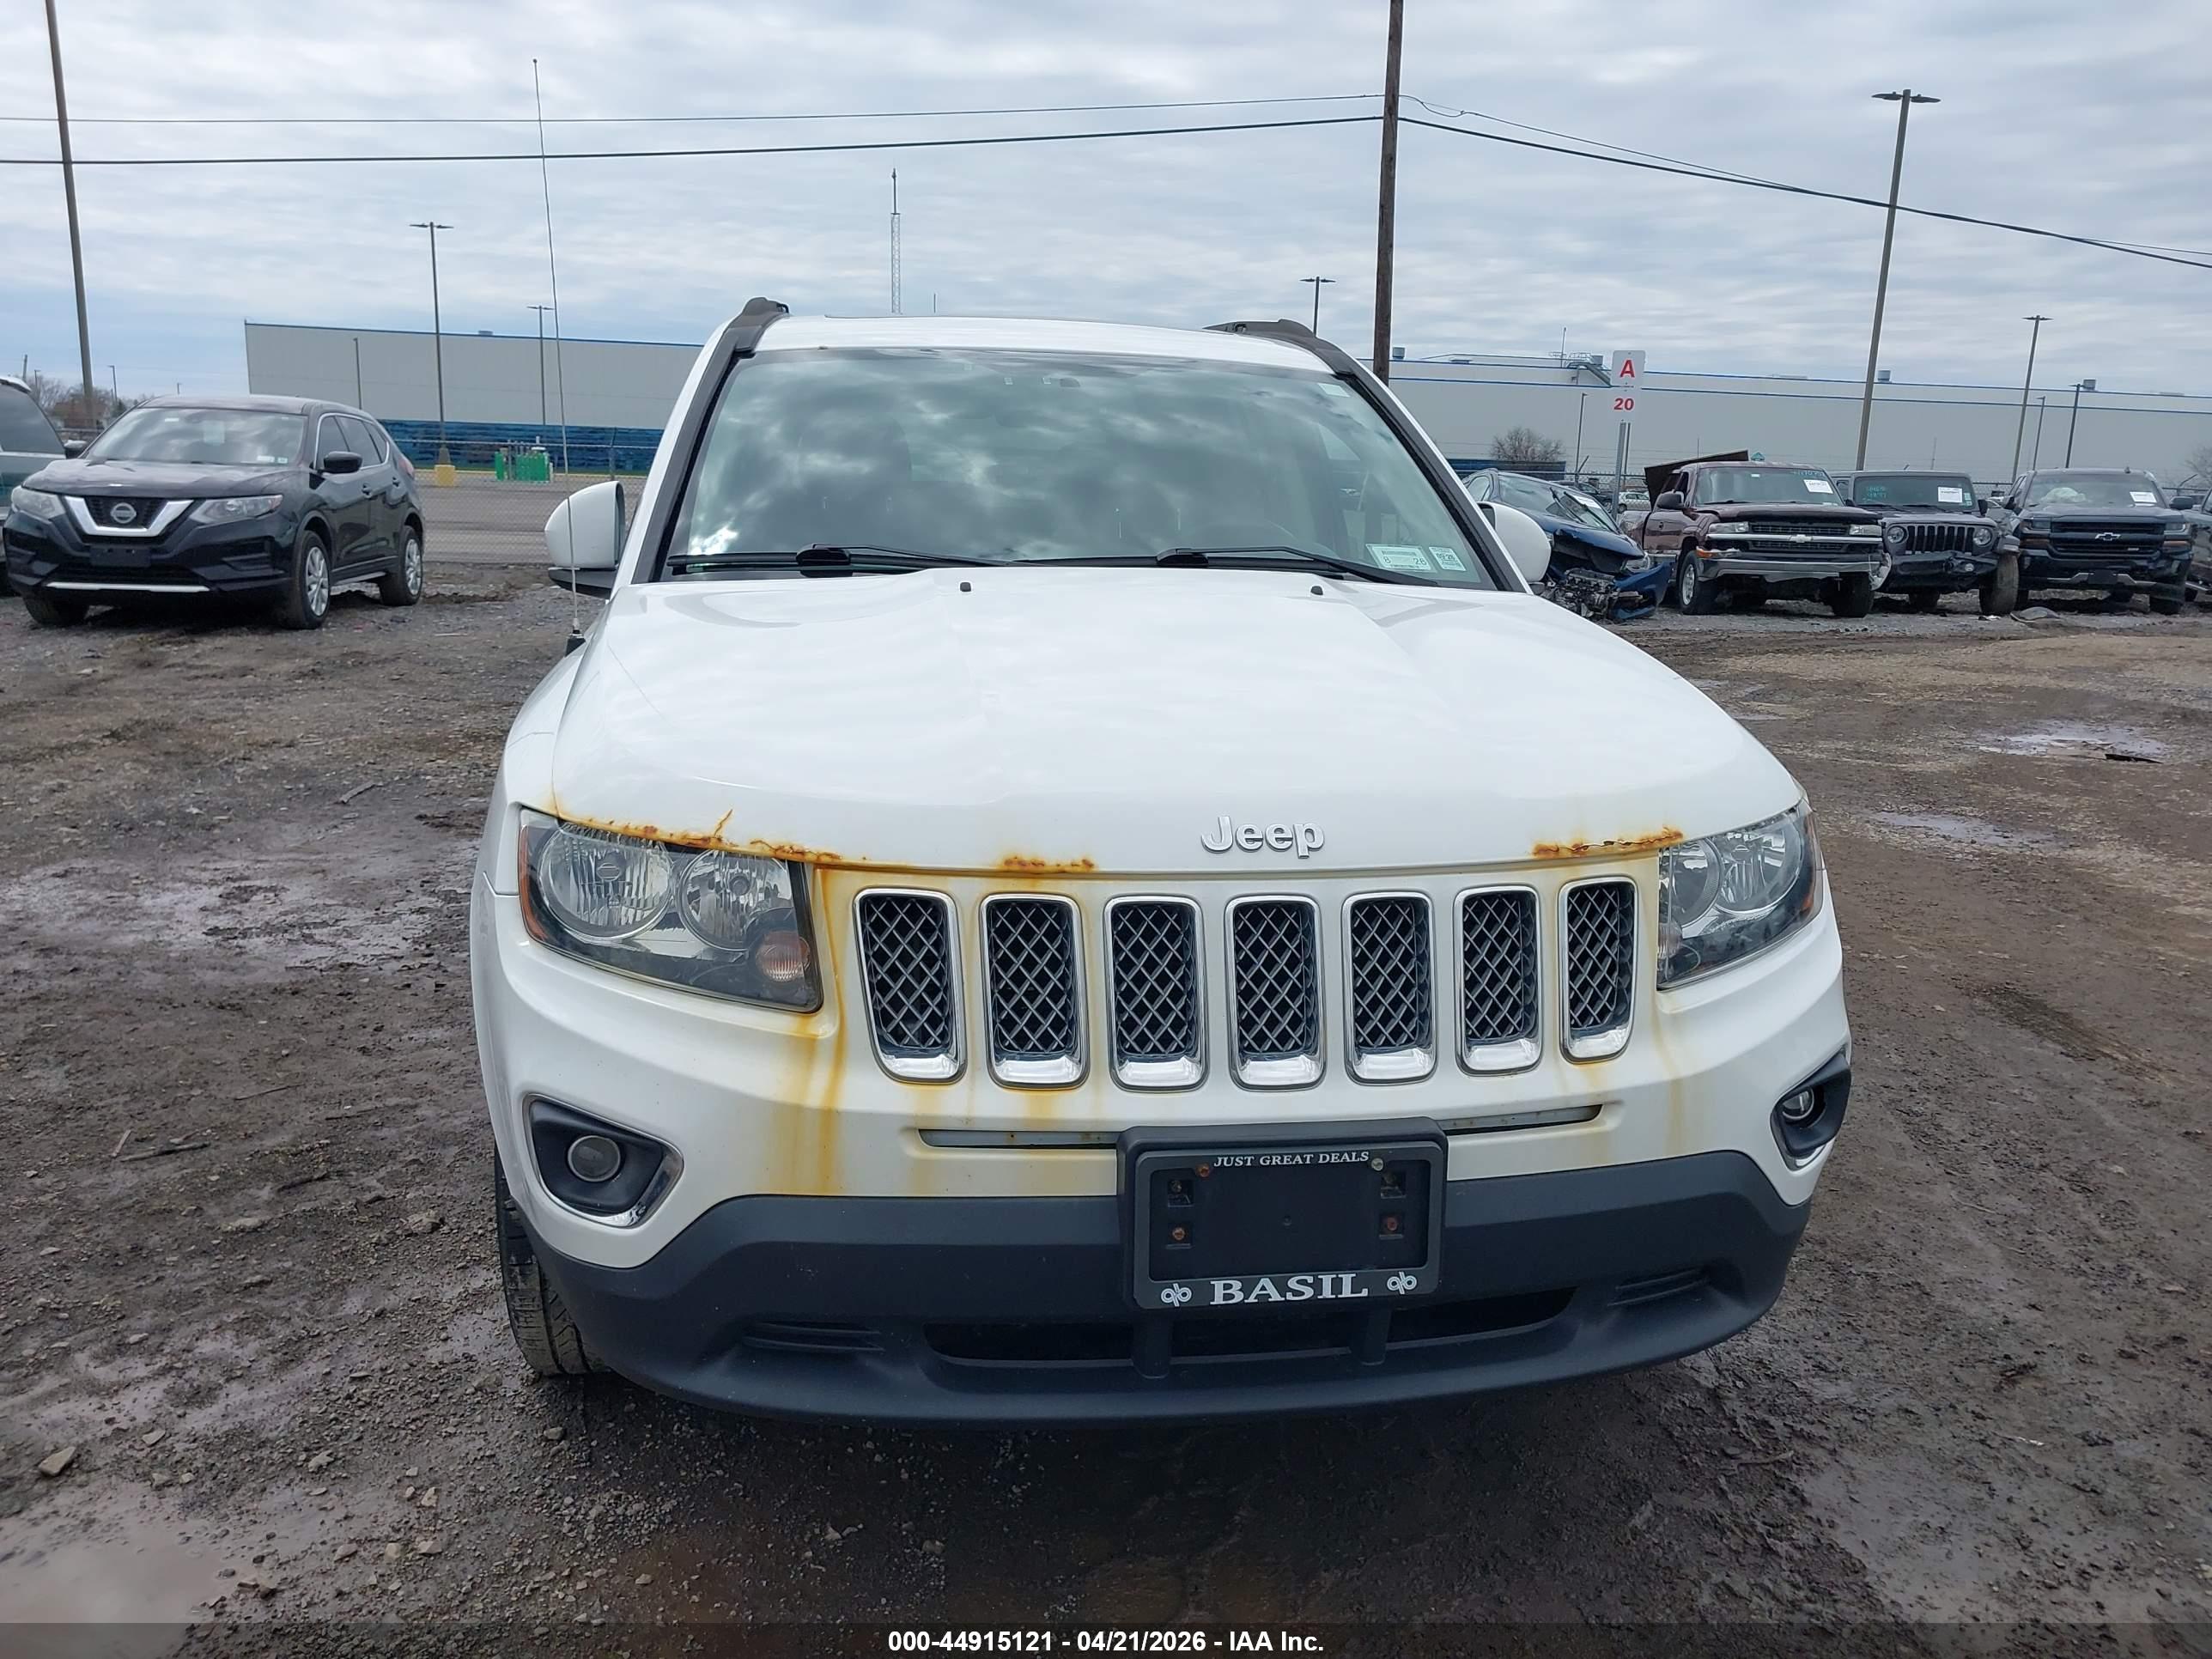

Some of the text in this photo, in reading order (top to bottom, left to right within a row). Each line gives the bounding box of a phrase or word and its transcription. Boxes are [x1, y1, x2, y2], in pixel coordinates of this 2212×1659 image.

[1620, 359, 1635, 378] A
[1613, 398, 1635, 410] 20
[1200, 815, 1325, 860] Jeep
[1213, 1151, 1370, 1168] JUST GREAT DEALS
[1209, 1273, 1369, 1305] BASIL
